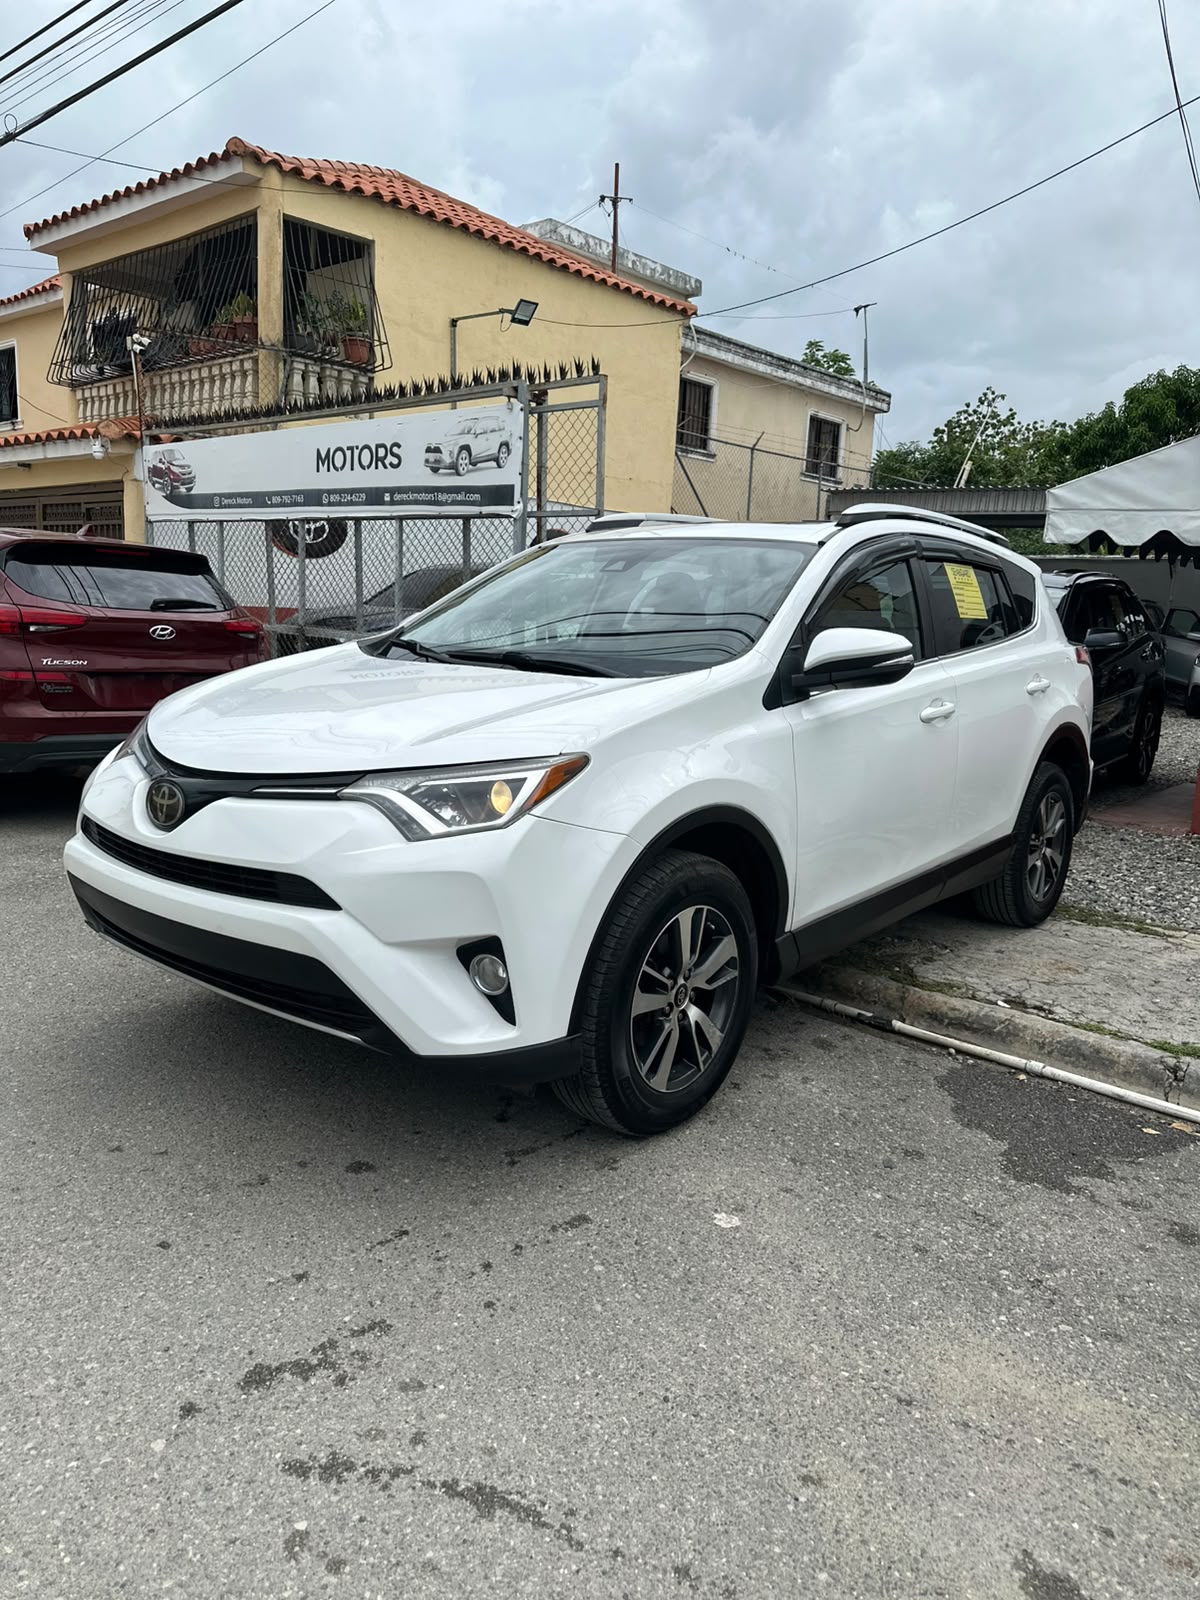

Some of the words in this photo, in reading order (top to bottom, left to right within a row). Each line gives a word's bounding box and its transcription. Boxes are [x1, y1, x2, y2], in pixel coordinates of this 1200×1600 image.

[315, 441, 402, 473] MOTORS
[221, 496, 236, 505] Dereck
[237, 496, 253, 505] Motors
[271, 494, 304, 504] 809-792-7163
[329, 493, 366, 503] 809-224-6229
[393, 491, 481, 503] dereckmotors18@gmail.com
